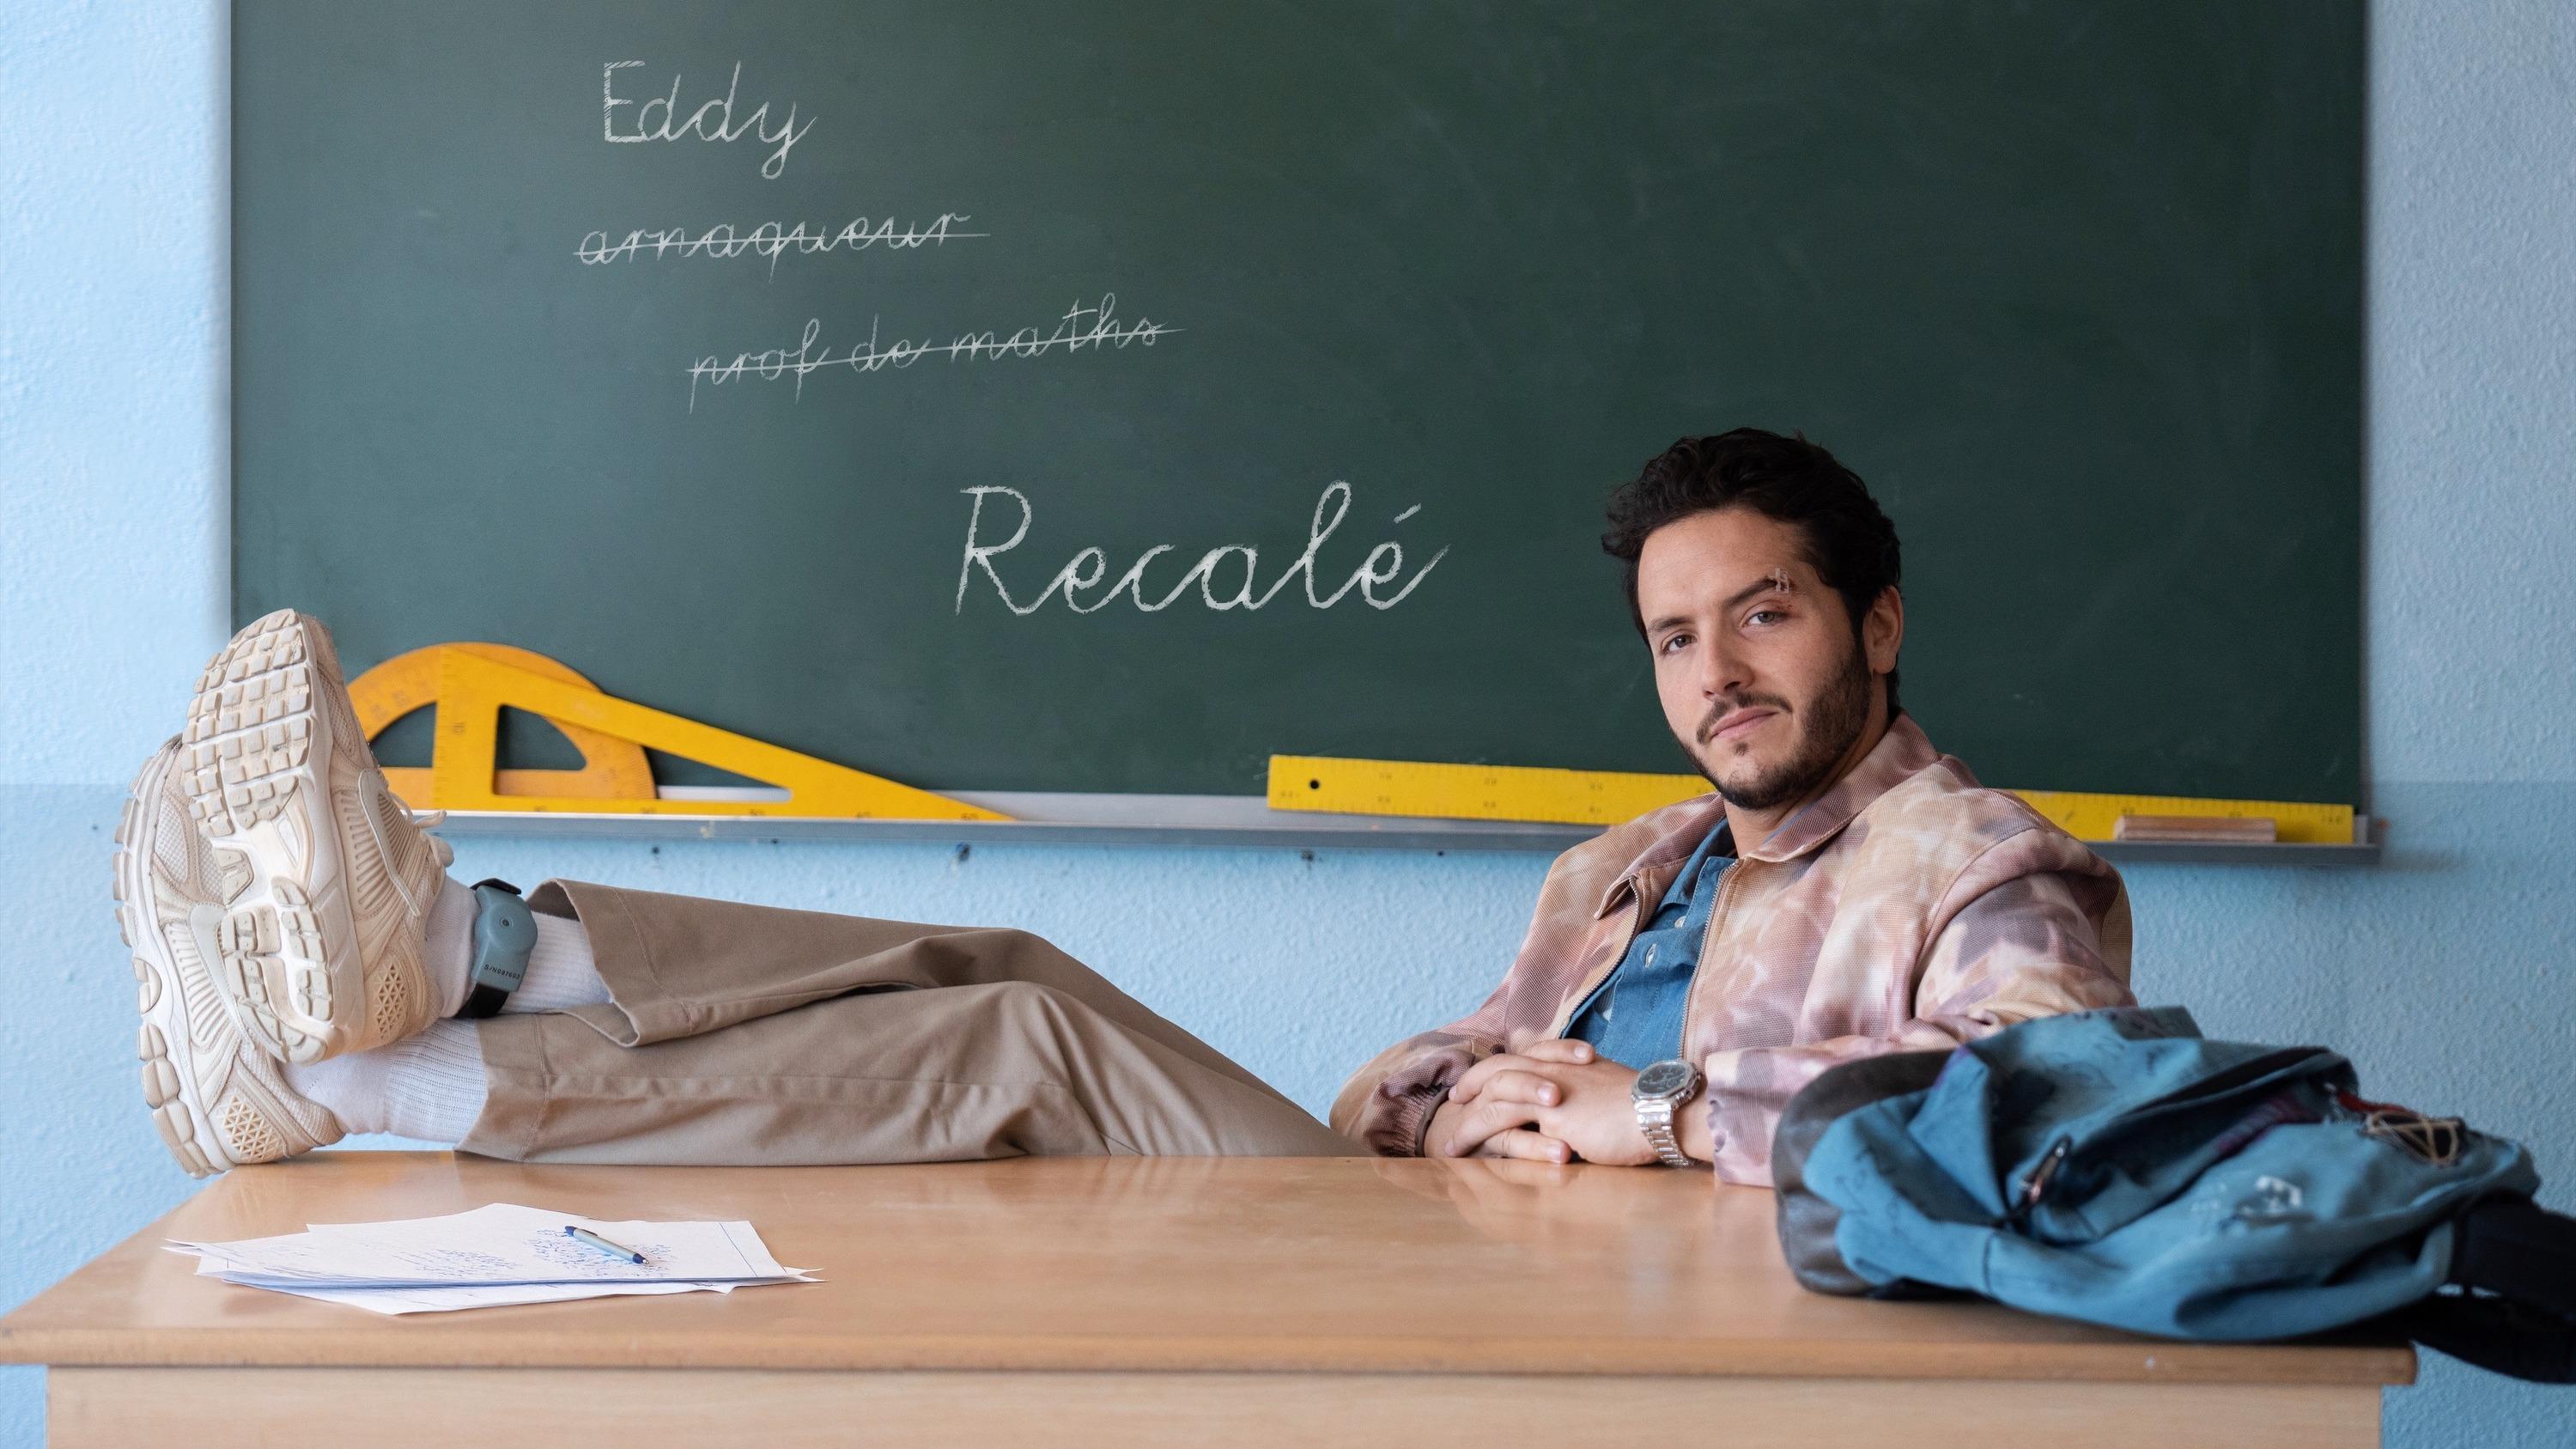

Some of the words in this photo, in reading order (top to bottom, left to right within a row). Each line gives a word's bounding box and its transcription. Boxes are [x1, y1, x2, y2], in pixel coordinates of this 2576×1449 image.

[603, 60, 818, 180] Eddy
[573, 211, 991, 283] arnaqueur
[685, 317, 831, 415] prof
[849, 313, 932, 374] de
[948, 292, 1187, 364] maths
[955, 479, 1452, 617] Recalé
